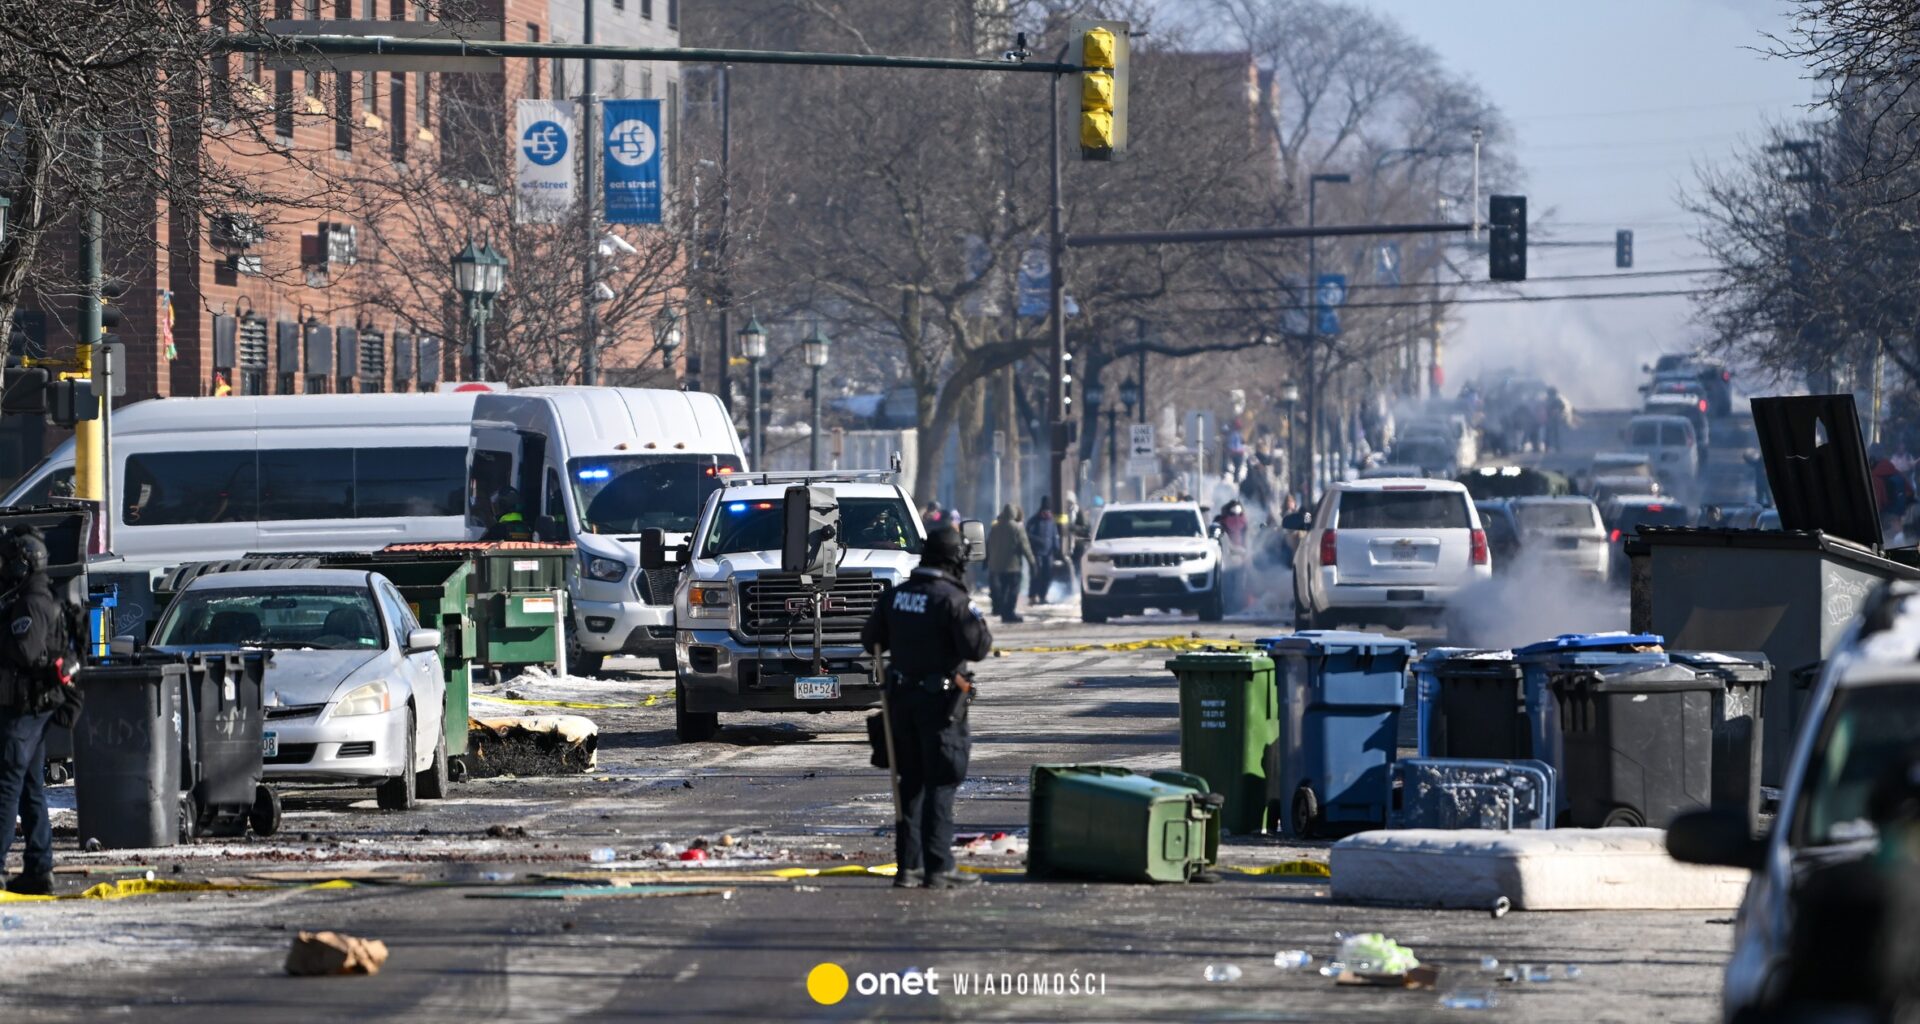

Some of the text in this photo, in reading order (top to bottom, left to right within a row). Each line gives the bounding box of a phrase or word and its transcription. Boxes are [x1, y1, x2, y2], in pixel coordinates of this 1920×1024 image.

[539, 181, 568, 189] street
[627, 180, 656, 188] street
[893, 591, 928, 613] POLICE
[798, 683, 814, 694] KBA
